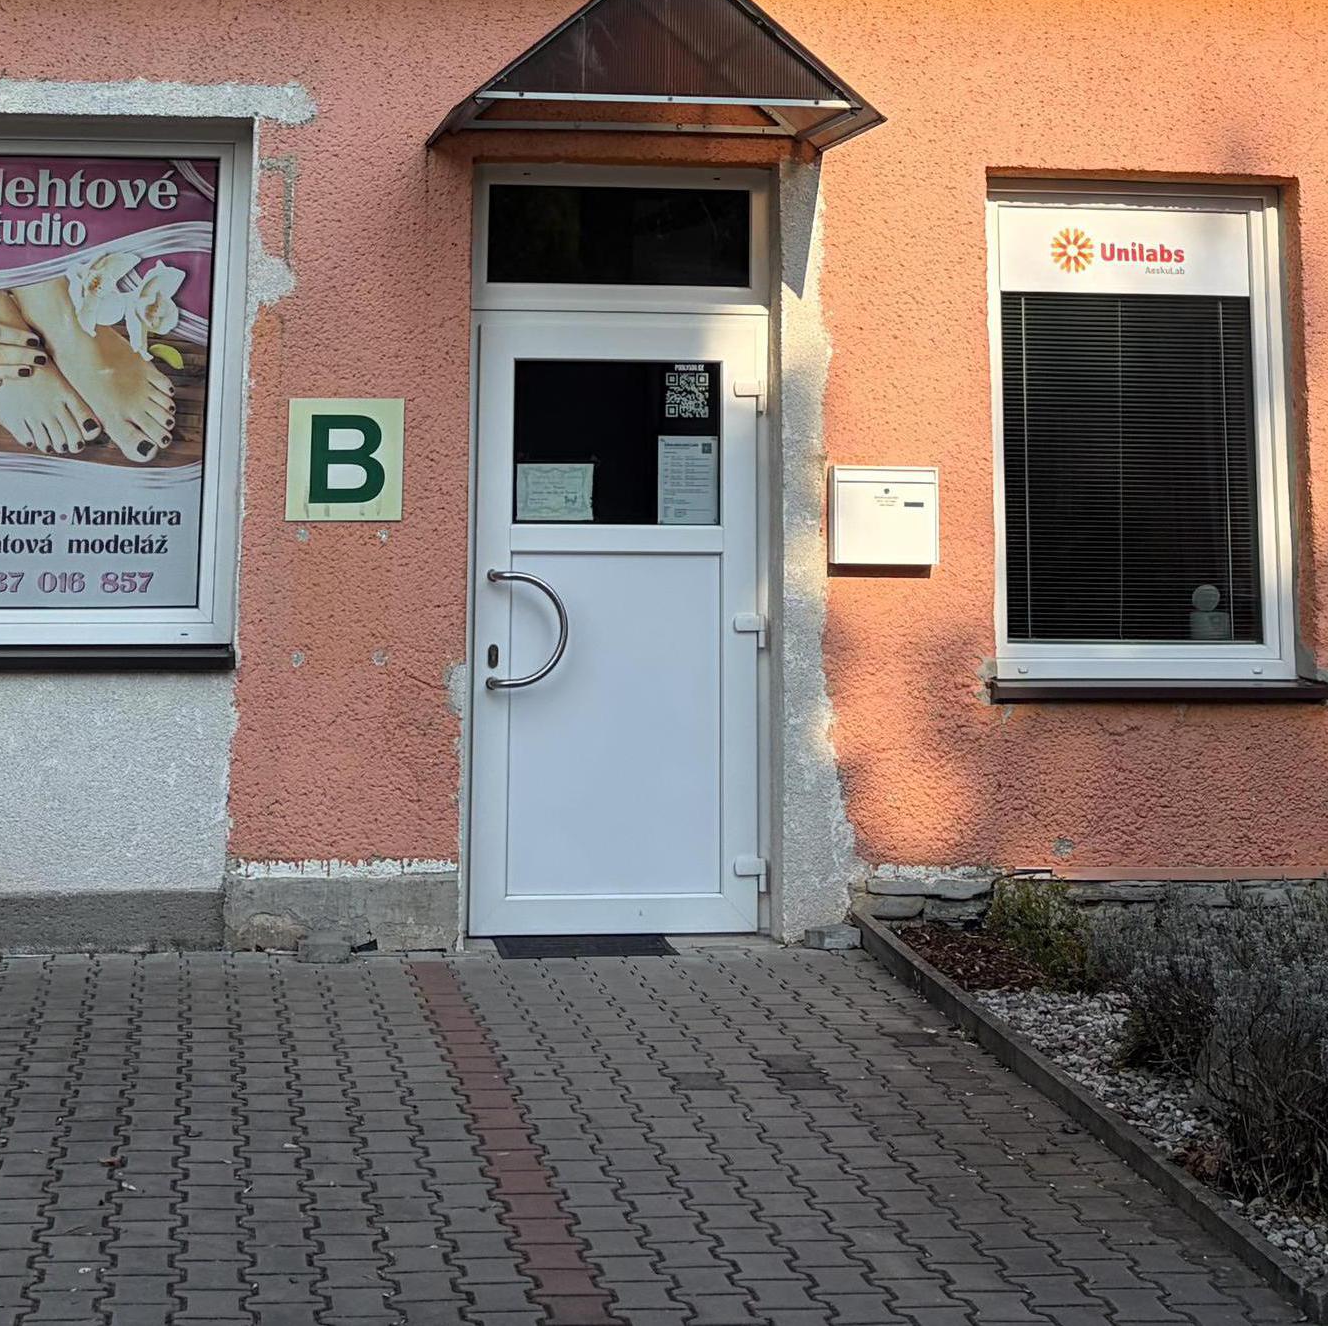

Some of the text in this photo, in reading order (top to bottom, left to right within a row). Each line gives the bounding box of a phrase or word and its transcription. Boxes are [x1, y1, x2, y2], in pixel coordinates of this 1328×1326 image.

[1100, 241, 1185, 263] Unilabs
[308, 414, 385, 504] B
[71, 506, 182, 526] Manikúra
[67, 534, 169, 554] modeláž
[37, 571, 86, 593] 016
[100, 571, 154, 593] 857
